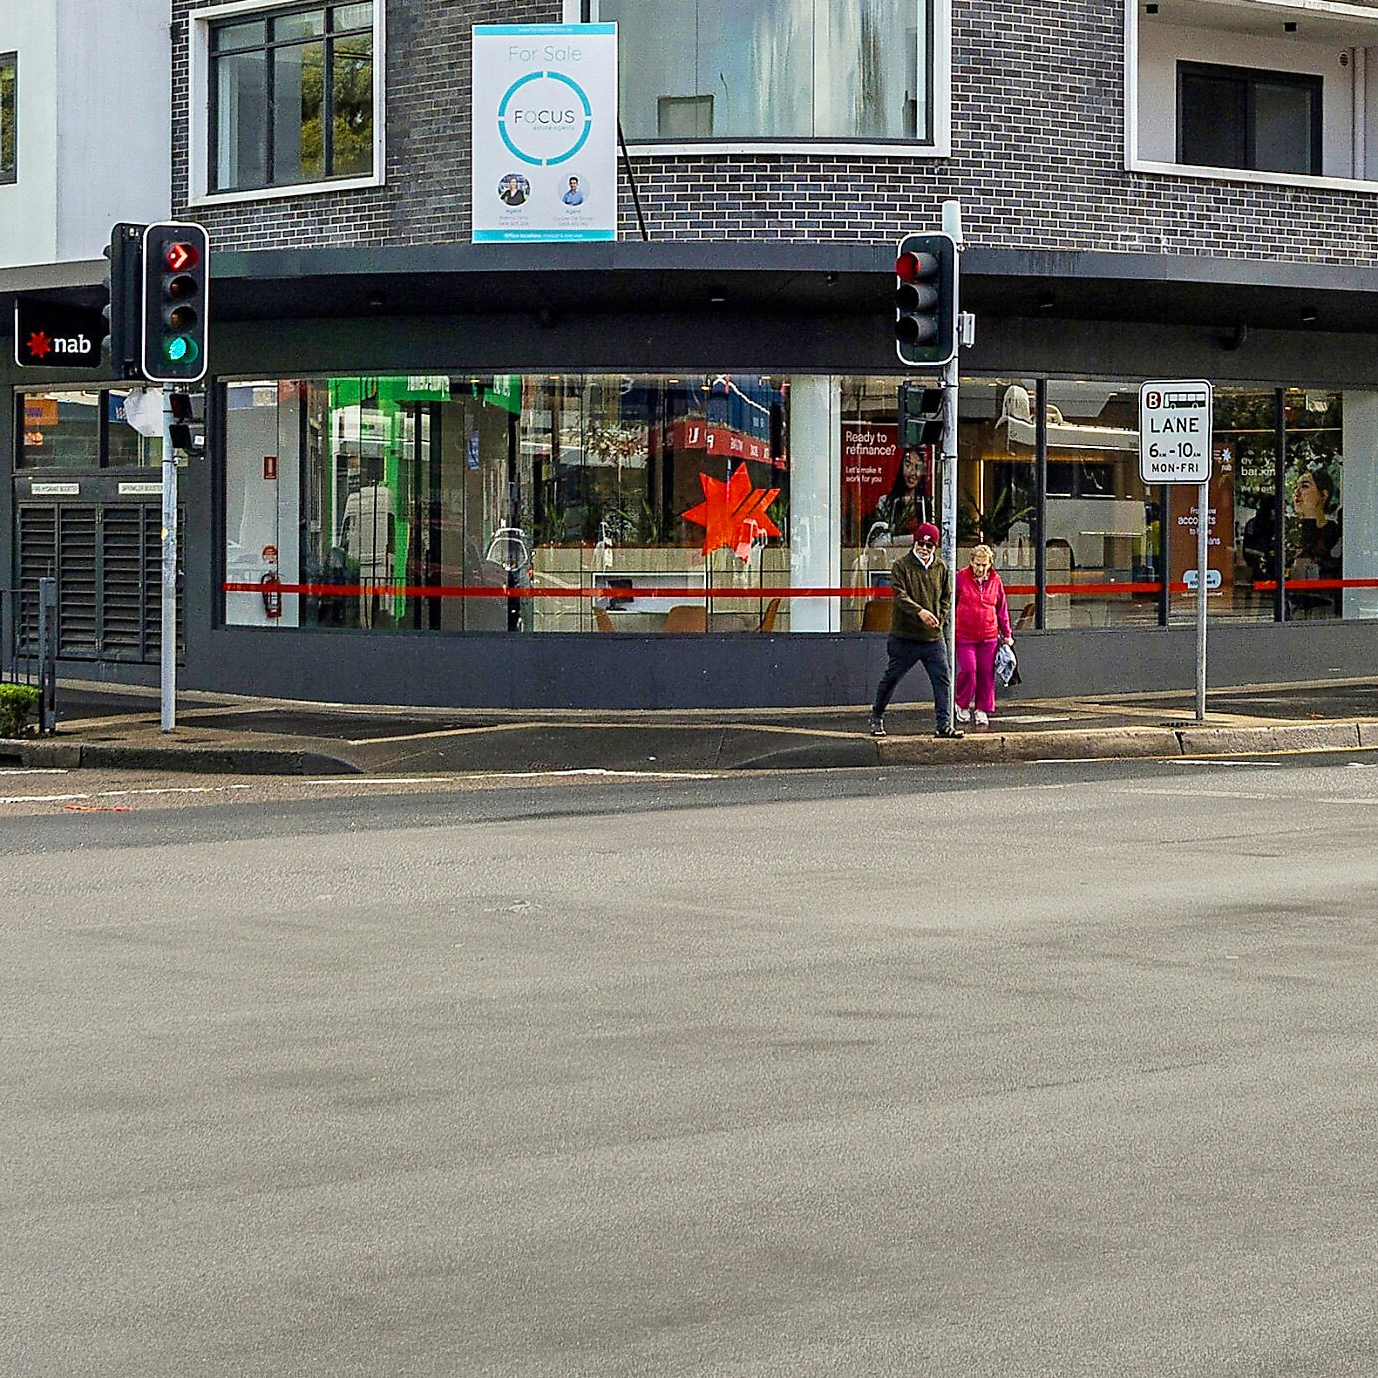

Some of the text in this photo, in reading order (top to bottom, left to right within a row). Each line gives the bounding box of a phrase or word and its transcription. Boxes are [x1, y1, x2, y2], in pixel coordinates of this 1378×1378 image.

[509, 44, 582, 62] For Sale
[514, 110, 575, 124] FOCUS
[54, 334, 92, 354] nab
[1148, 392, 1158, 408] B
[1150, 417, 1199, 433] LANE
[845, 430, 887, 446] Ready to
[845, 443, 897, 456] refinance?
[845, 466, 861, 474] Let's
[861, 466, 877, 474] make
[1151, 463, 1199, 473] MON-FRI
[845, 475, 882, 485] work for you
[1177, 516, 1216, 525] accots
